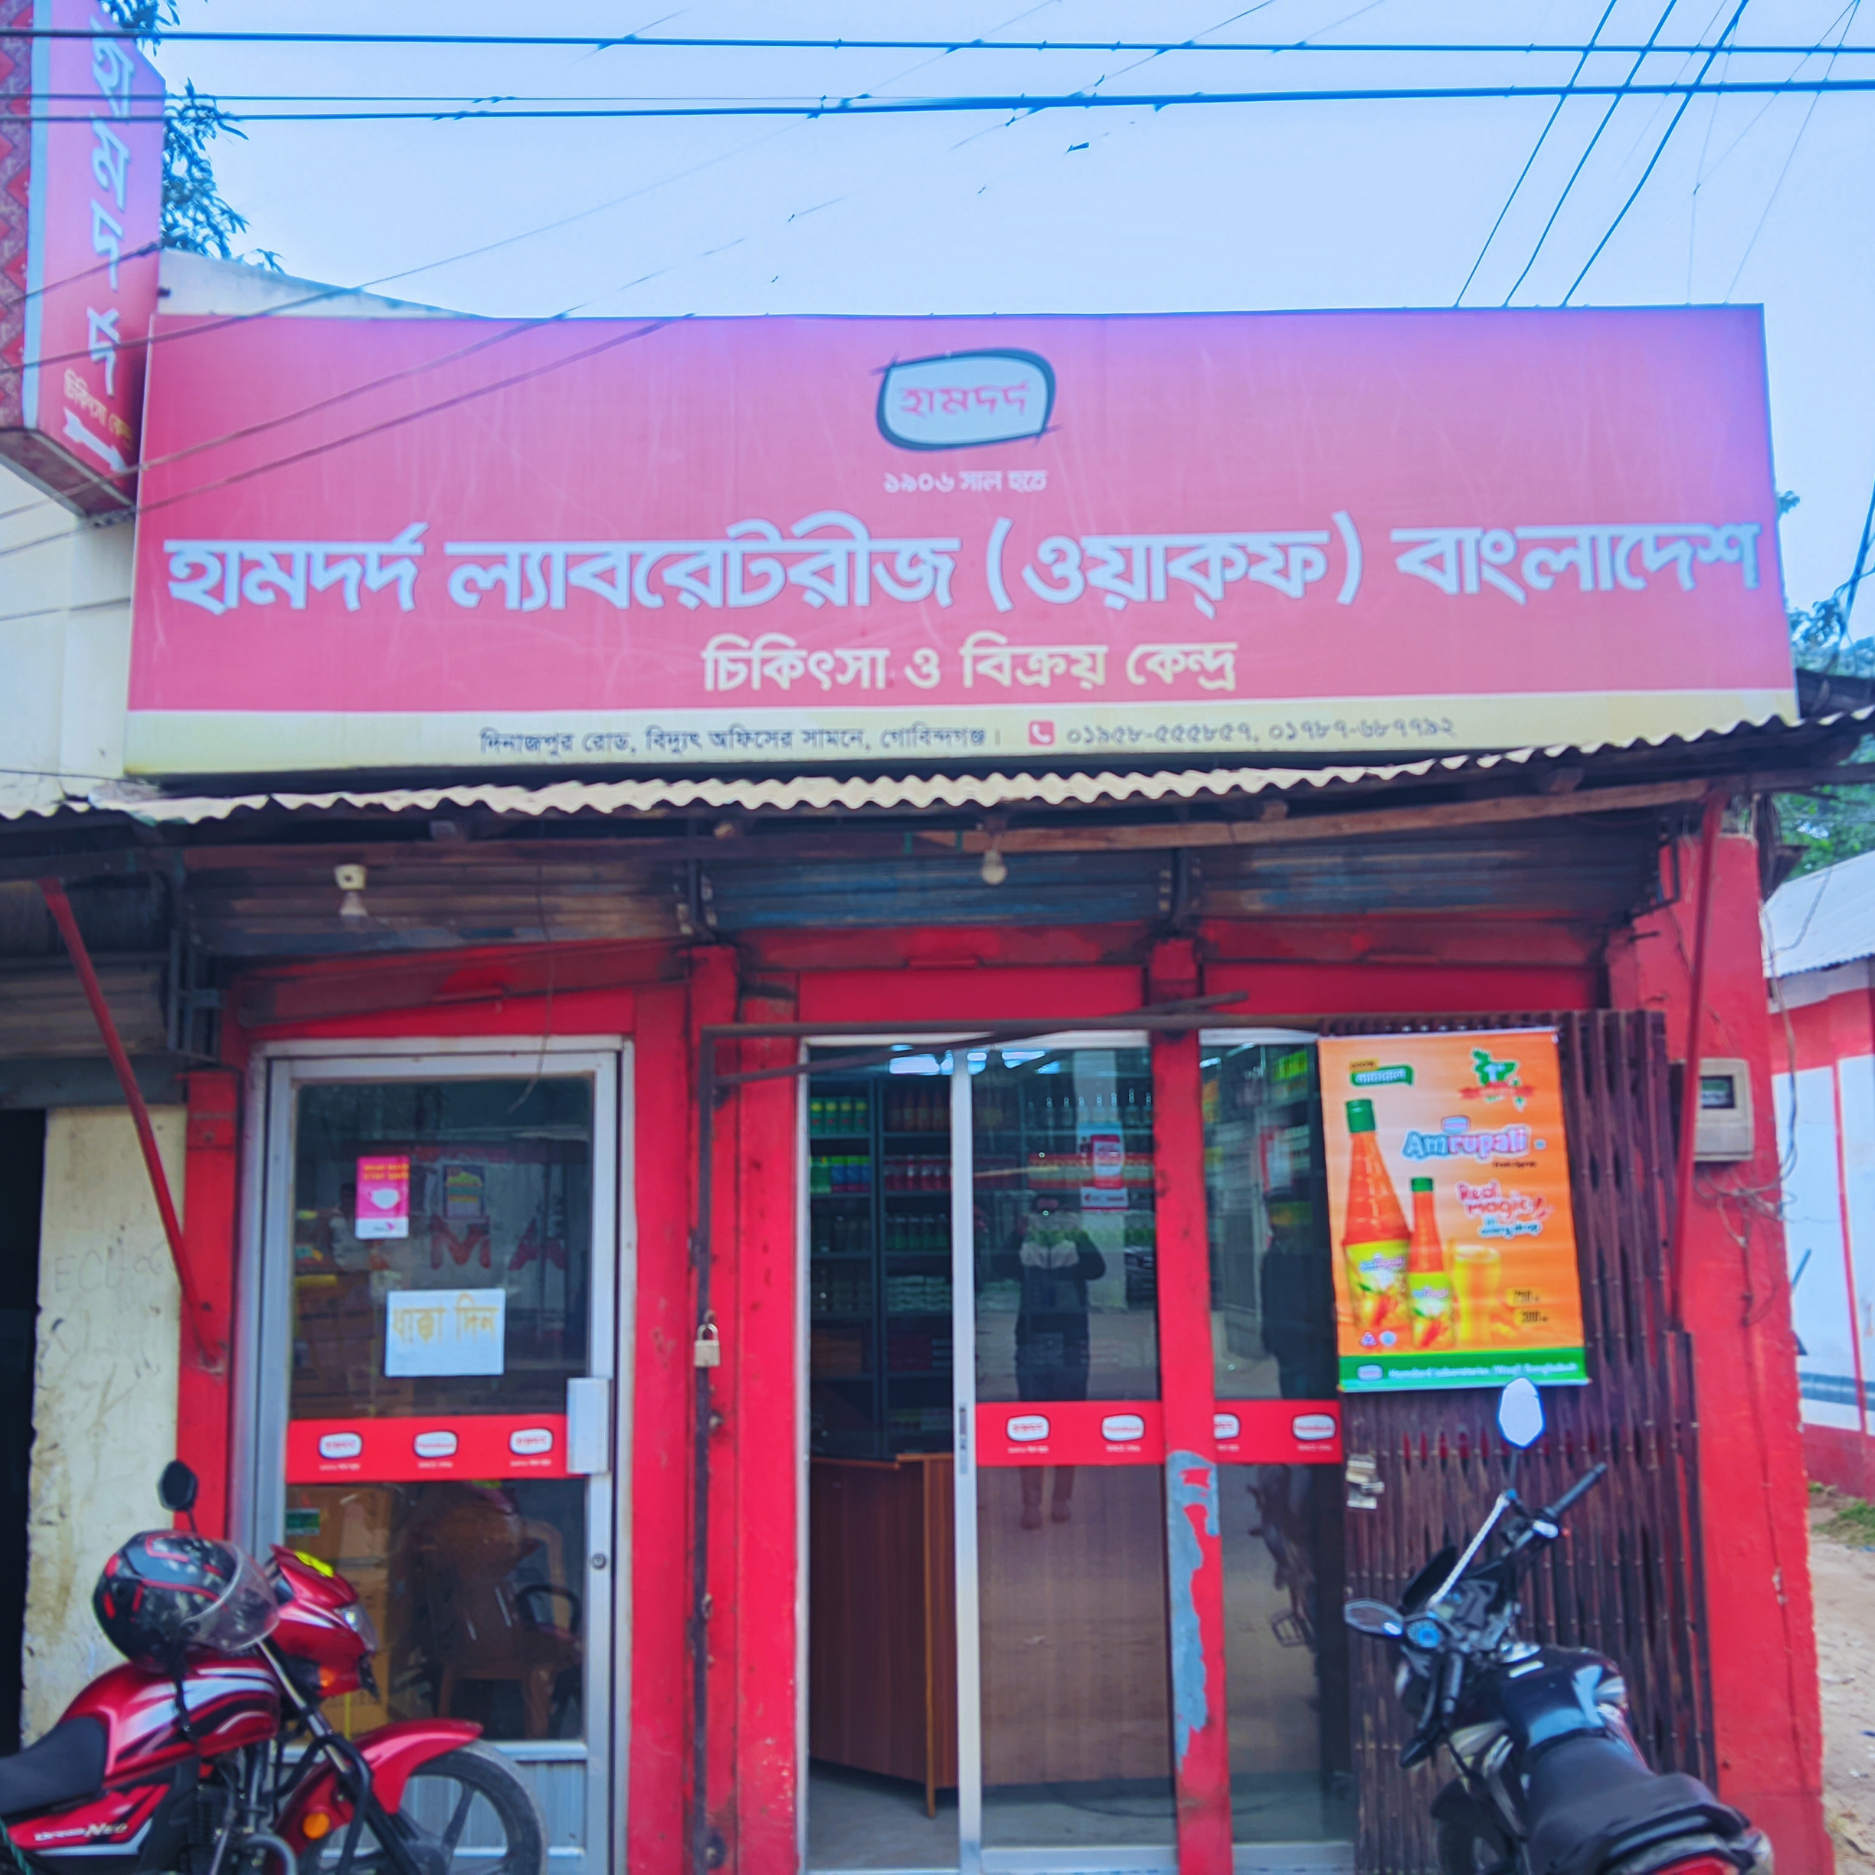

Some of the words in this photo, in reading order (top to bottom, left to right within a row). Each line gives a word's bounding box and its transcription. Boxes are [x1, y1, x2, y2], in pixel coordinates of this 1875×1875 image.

[902, 378, 1030, 418] হামদর্দ
[884, 472, 955, 493] ১৯০৬
[959, 470, 1003, 492] সাল
[164, 522, 429, 615] হামদর্দ
[444, 511, 961, 611] ল্যাবরেটরীজ
[1391, 523, 1762, 606] বাংলাদেশ
[703, 633, 889, 691] চিকিৎসা
[904, 647, 940, 688] ও
[960, 630, 1107, 690] বিক্রয়
[1126, 642, 1238, 690] কেন্দ্র
[480, 727, 573, 757] দিনাজপুর
[582, 731, 636, 755] রোড,
[645, 724, 702, 754] বিদ্যুৎ
[708, 722, 793, 751] অফিসের
[801, 728, 871, 752] সামনে,
[1402, 1128, 1528, 1161] Amrupali
[455, 1293, 498, 1343] দিন
